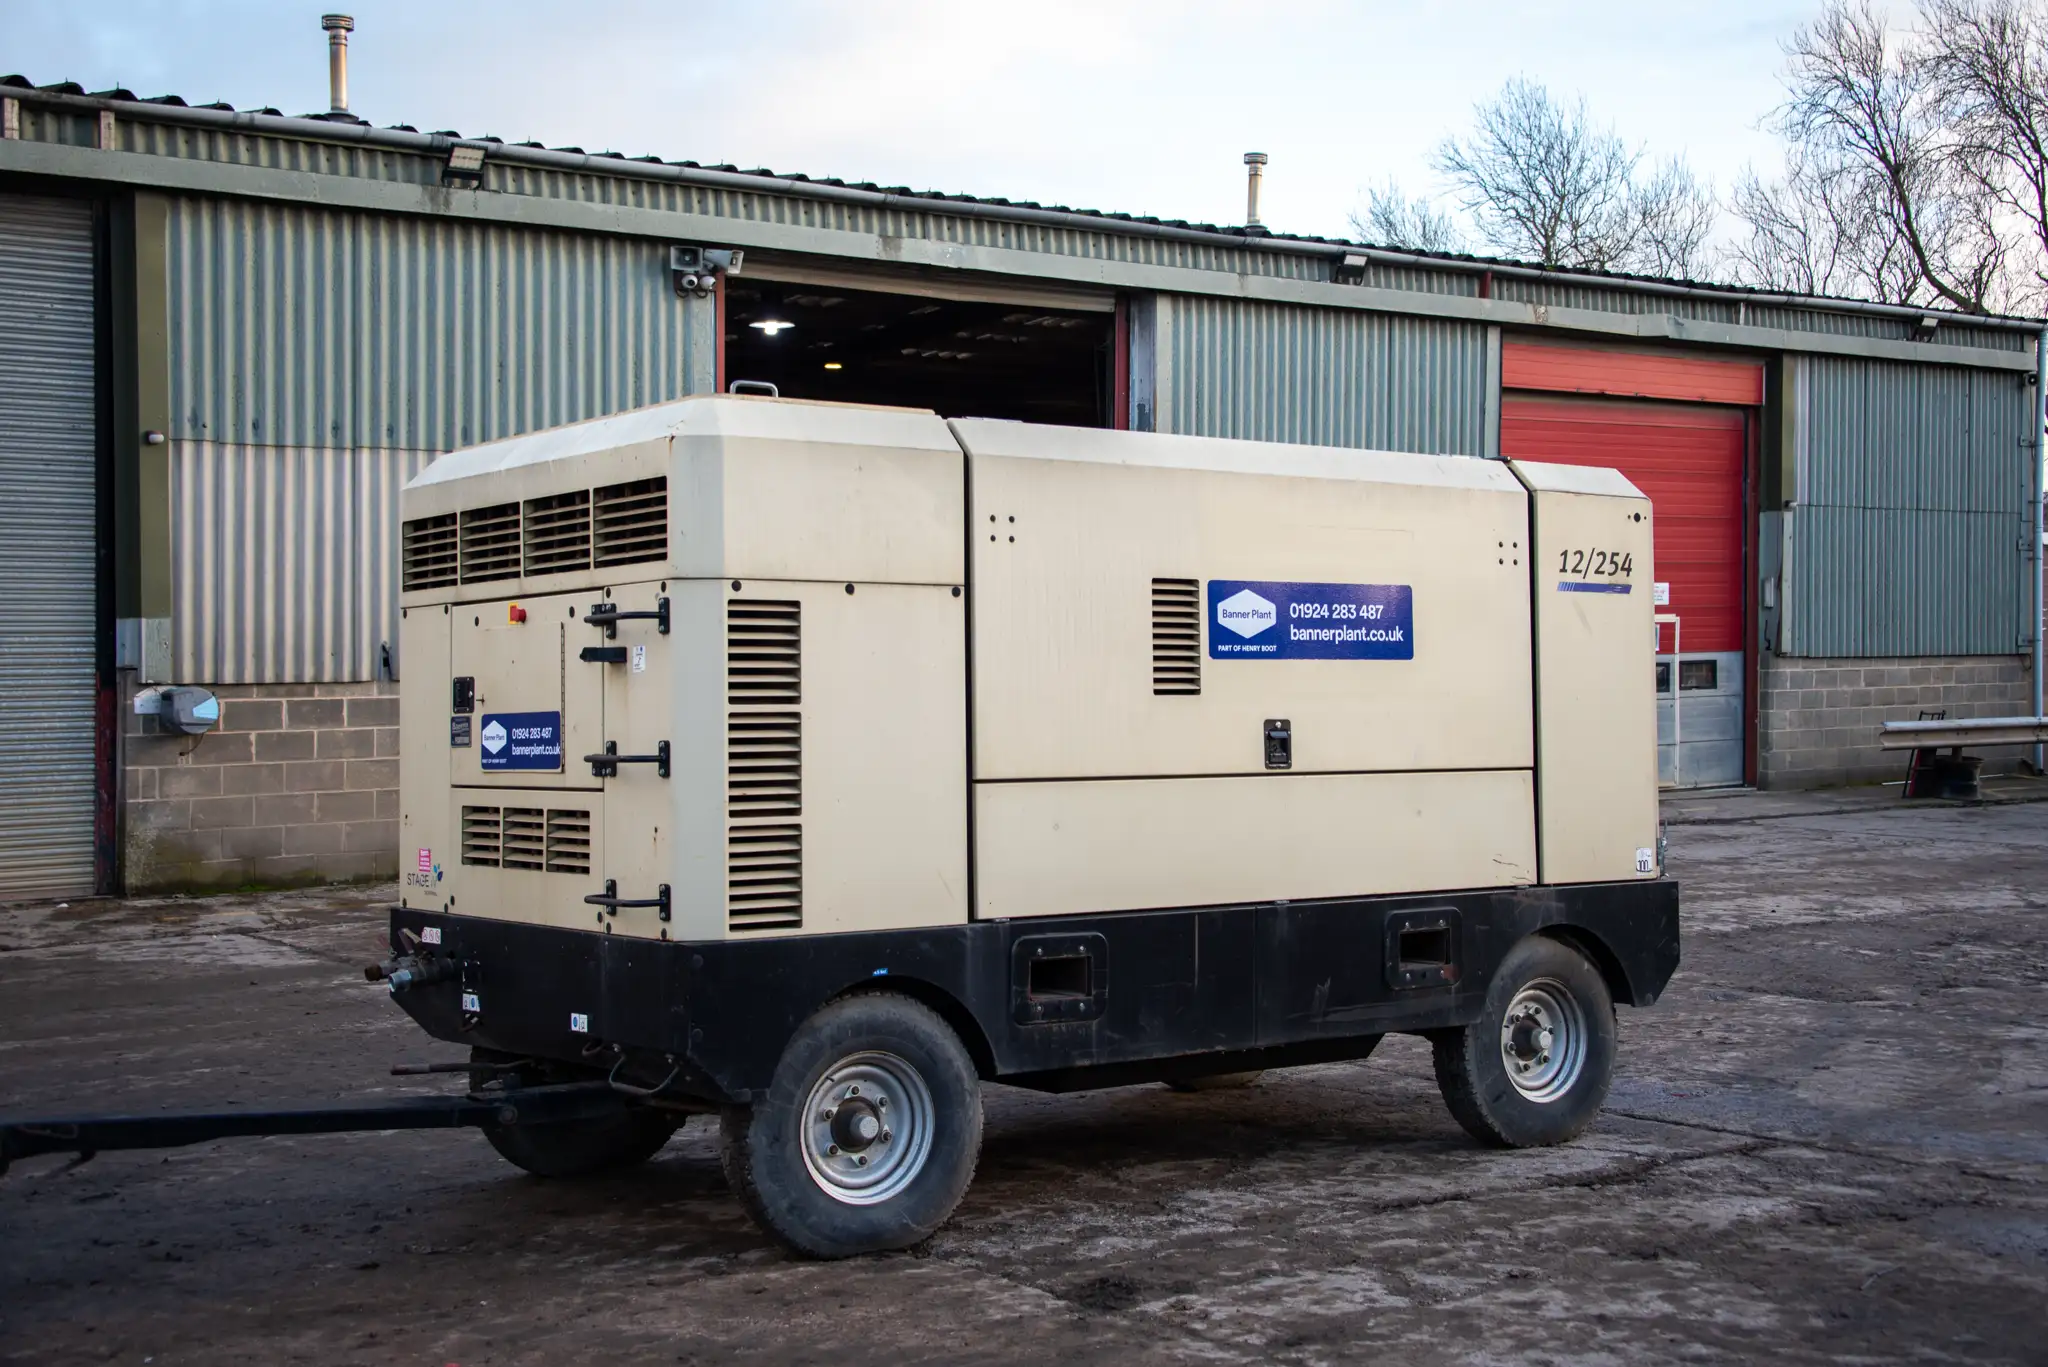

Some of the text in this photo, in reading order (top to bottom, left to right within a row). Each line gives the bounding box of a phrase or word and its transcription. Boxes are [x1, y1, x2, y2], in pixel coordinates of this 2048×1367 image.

[1559, 548, 1632, 579] 12/254
[1222, 609, 1272, 620] Banner Plant
[1290, 603, 1384, 620] 01924 283 487
[1290, 624, 1403, 644] bannerplant.co.uk
[512, 727, 553, 740] 01924 283 487
[512, 742, 560, 757] bannerplant.co.uk
[407, 873, 429, 888] STAGE
